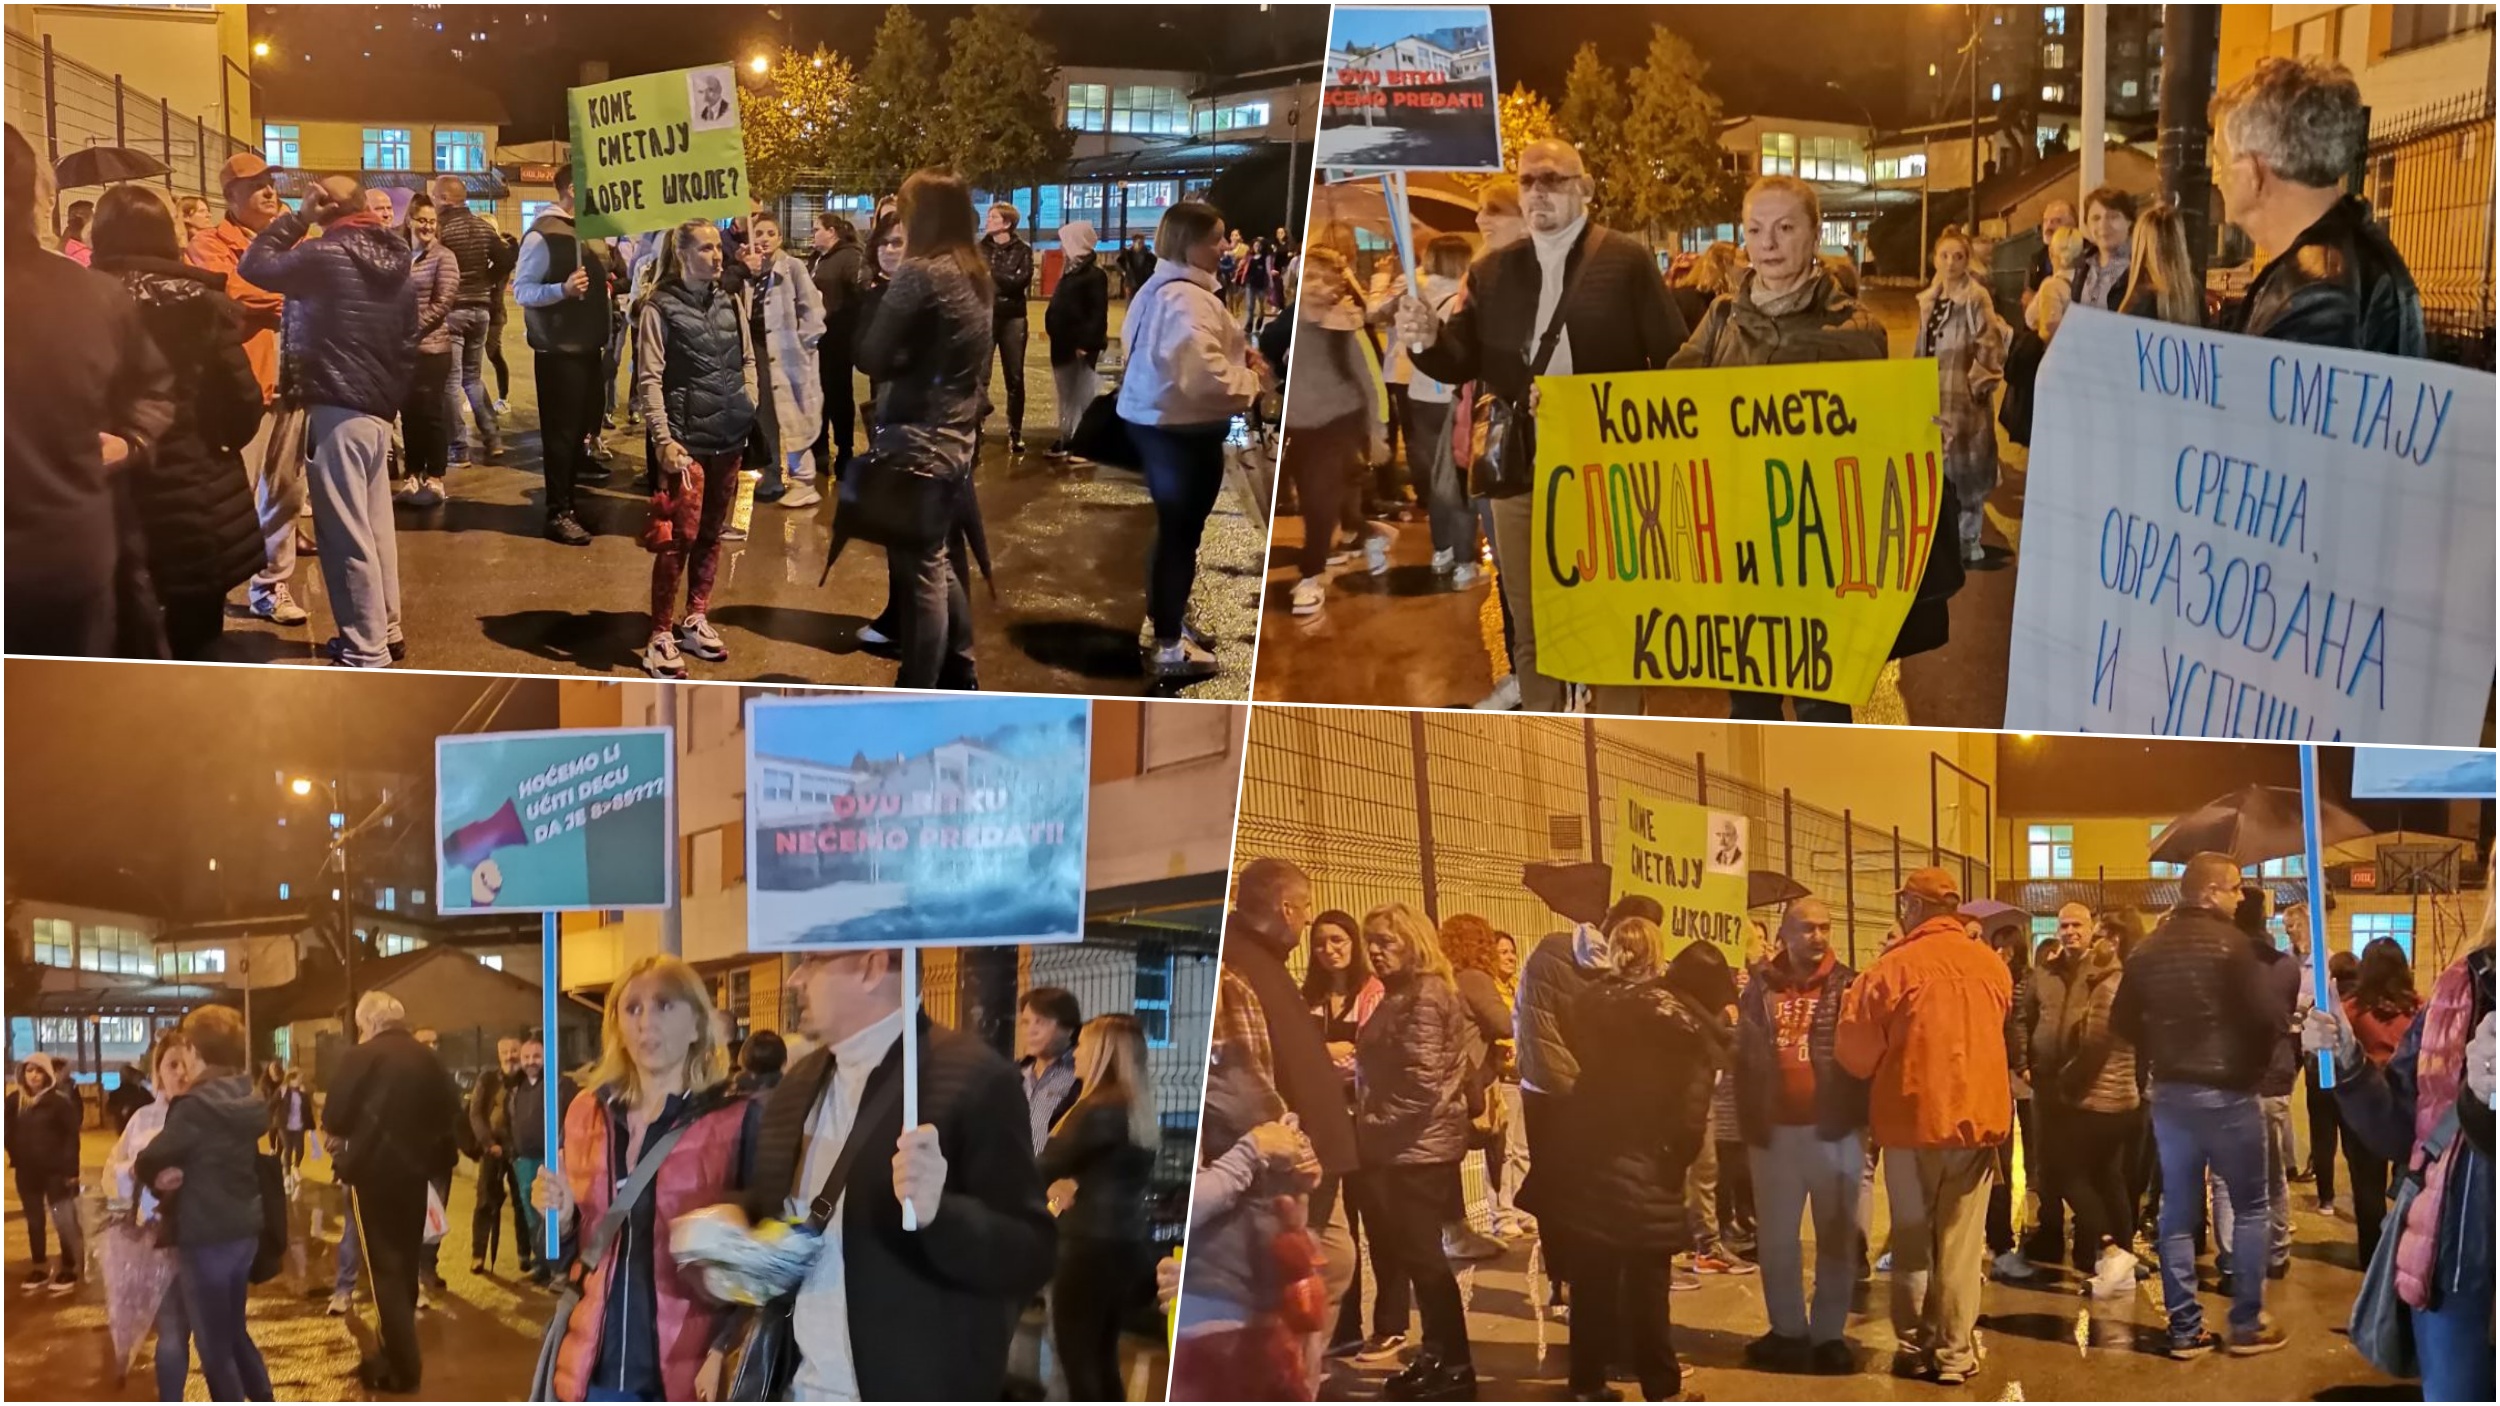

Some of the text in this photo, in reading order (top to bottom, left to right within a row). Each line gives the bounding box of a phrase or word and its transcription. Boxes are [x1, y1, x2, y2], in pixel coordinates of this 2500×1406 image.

[1338, 69, 1446, 86] OVU BITKU
[588, 90, 637, 128] КОМЕ
[598, 122, 689, 166] СМЕТАЈУ
[583, 167, 738, 216] ДОБРЕ ШКОЛЕ?
[2135, 327, 2454, 466] КОМЕ СМЕТАЈУ
[1546, 451, 1937, 598] СЛОЖАН и РАДАН
[2100, 508, 2386, 711] ОБРАЗОВАНА
[1633, 607, 1834, 692] КОЛЕКТИВ
[2092, 619, 2122, 713] И
[518, 742, 621, 800] HOĆEMO LI
[578, 764, 629, 801] DECU
[534, 818, 562, 844] DA
[565, 807, 587, 832] JE
[833, 793, 900, 818] OVU
[1672, 905, 1742, 946] ШКОЛЕ?
